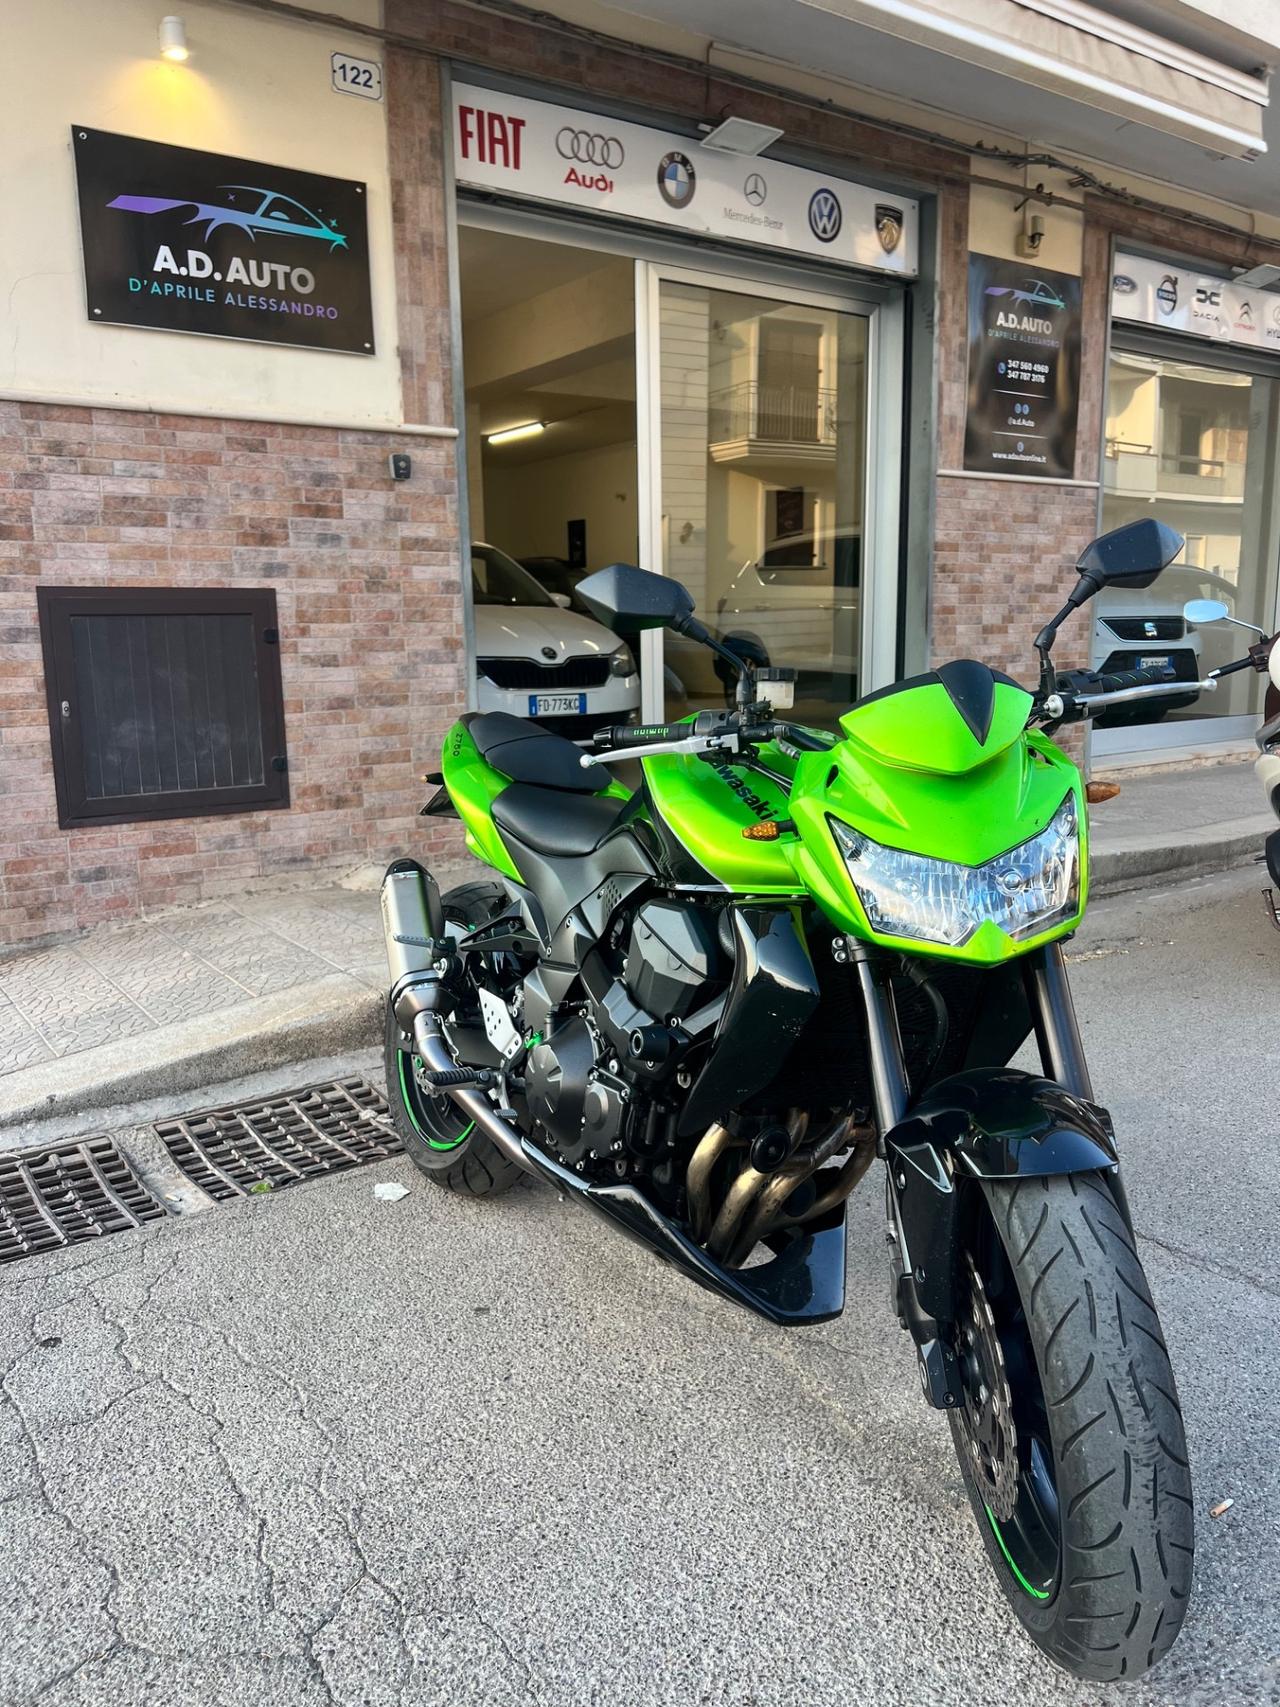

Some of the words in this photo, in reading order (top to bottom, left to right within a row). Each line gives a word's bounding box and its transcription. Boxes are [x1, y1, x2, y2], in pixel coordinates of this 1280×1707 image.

[338, 63, 374, 89] 122
[458, 104, 526, 170] FIAT
[564, 167, 614, 193] Audi
[723, 207, 784, 231] Mercedes-Benz
[128, 277, 216, 303] D'APRILE
[224, 292, 338, 320] ALESSANDRO
[1193, 310, 1220, 323] DACIA
[1007, 359, 1020, 369] 347
